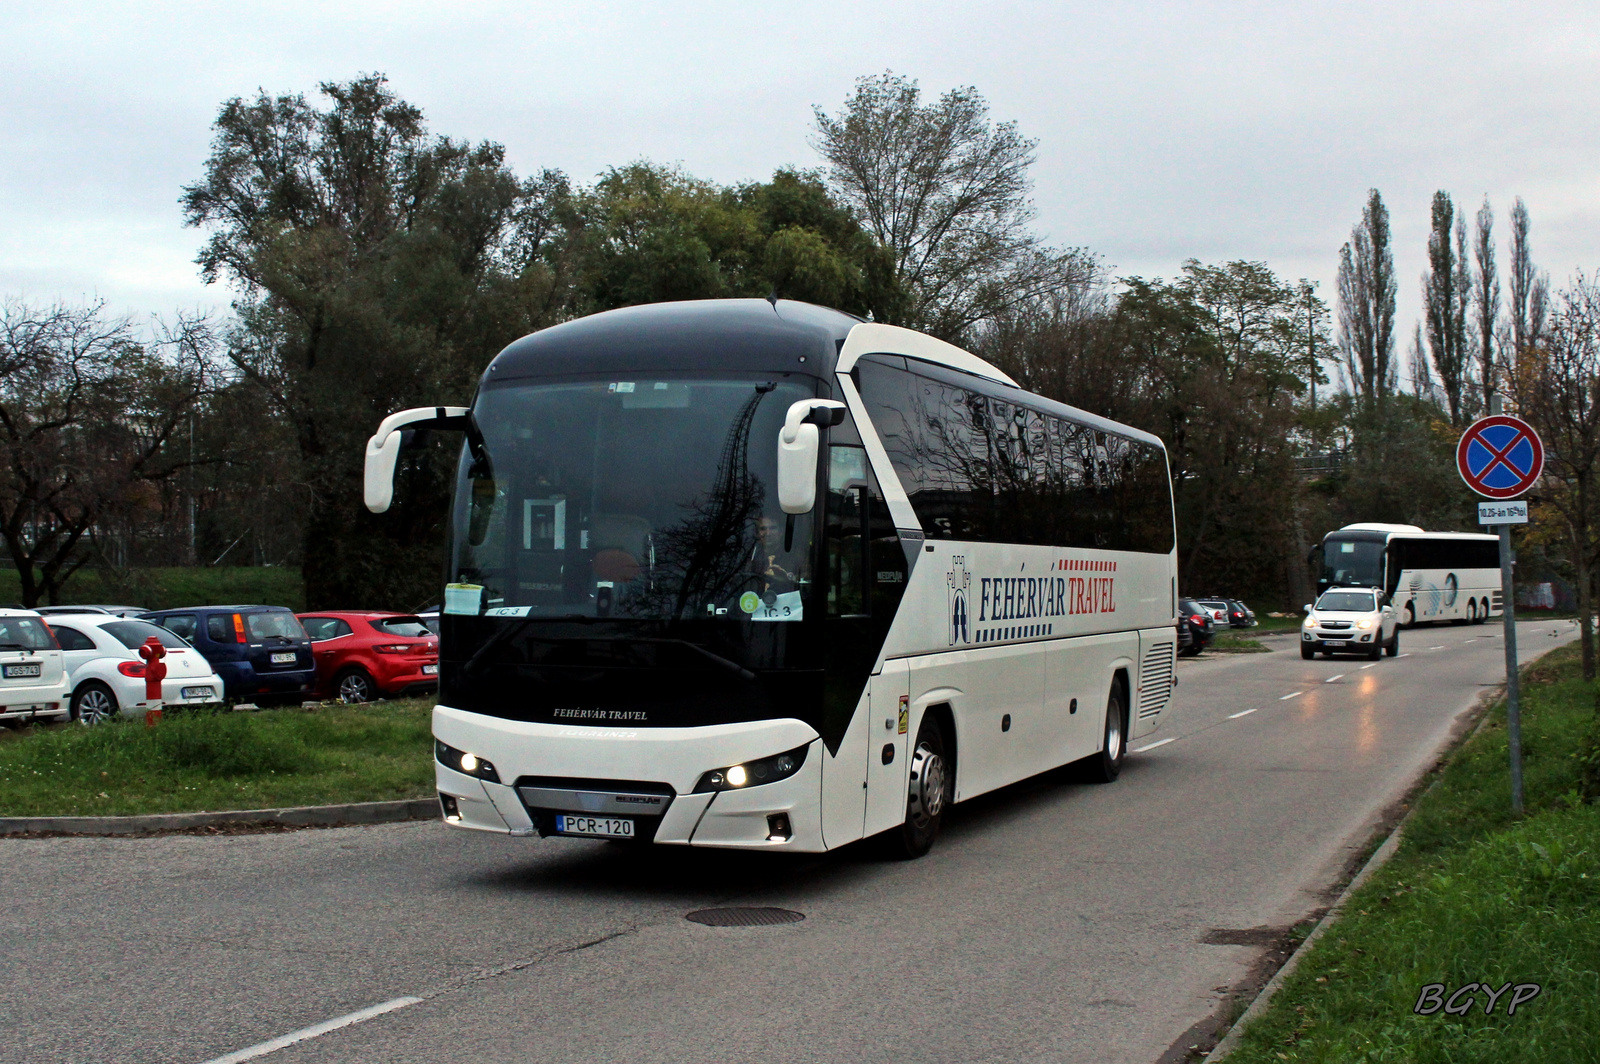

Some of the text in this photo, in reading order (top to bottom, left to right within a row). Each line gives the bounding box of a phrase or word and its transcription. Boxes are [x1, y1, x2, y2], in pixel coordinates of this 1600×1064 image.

[979, 562, 1116, 622] FEHÉRVÁR TRAVEL
[495, 608, 520, 616] IC 3
[782, 605, 792, 617] 3
[9, 666, 39, 676] JGS-743
[553, 707, 648, 721] FEHÉRVÁR TRAVEL
[566, 817, 631, 835] PCR-120
